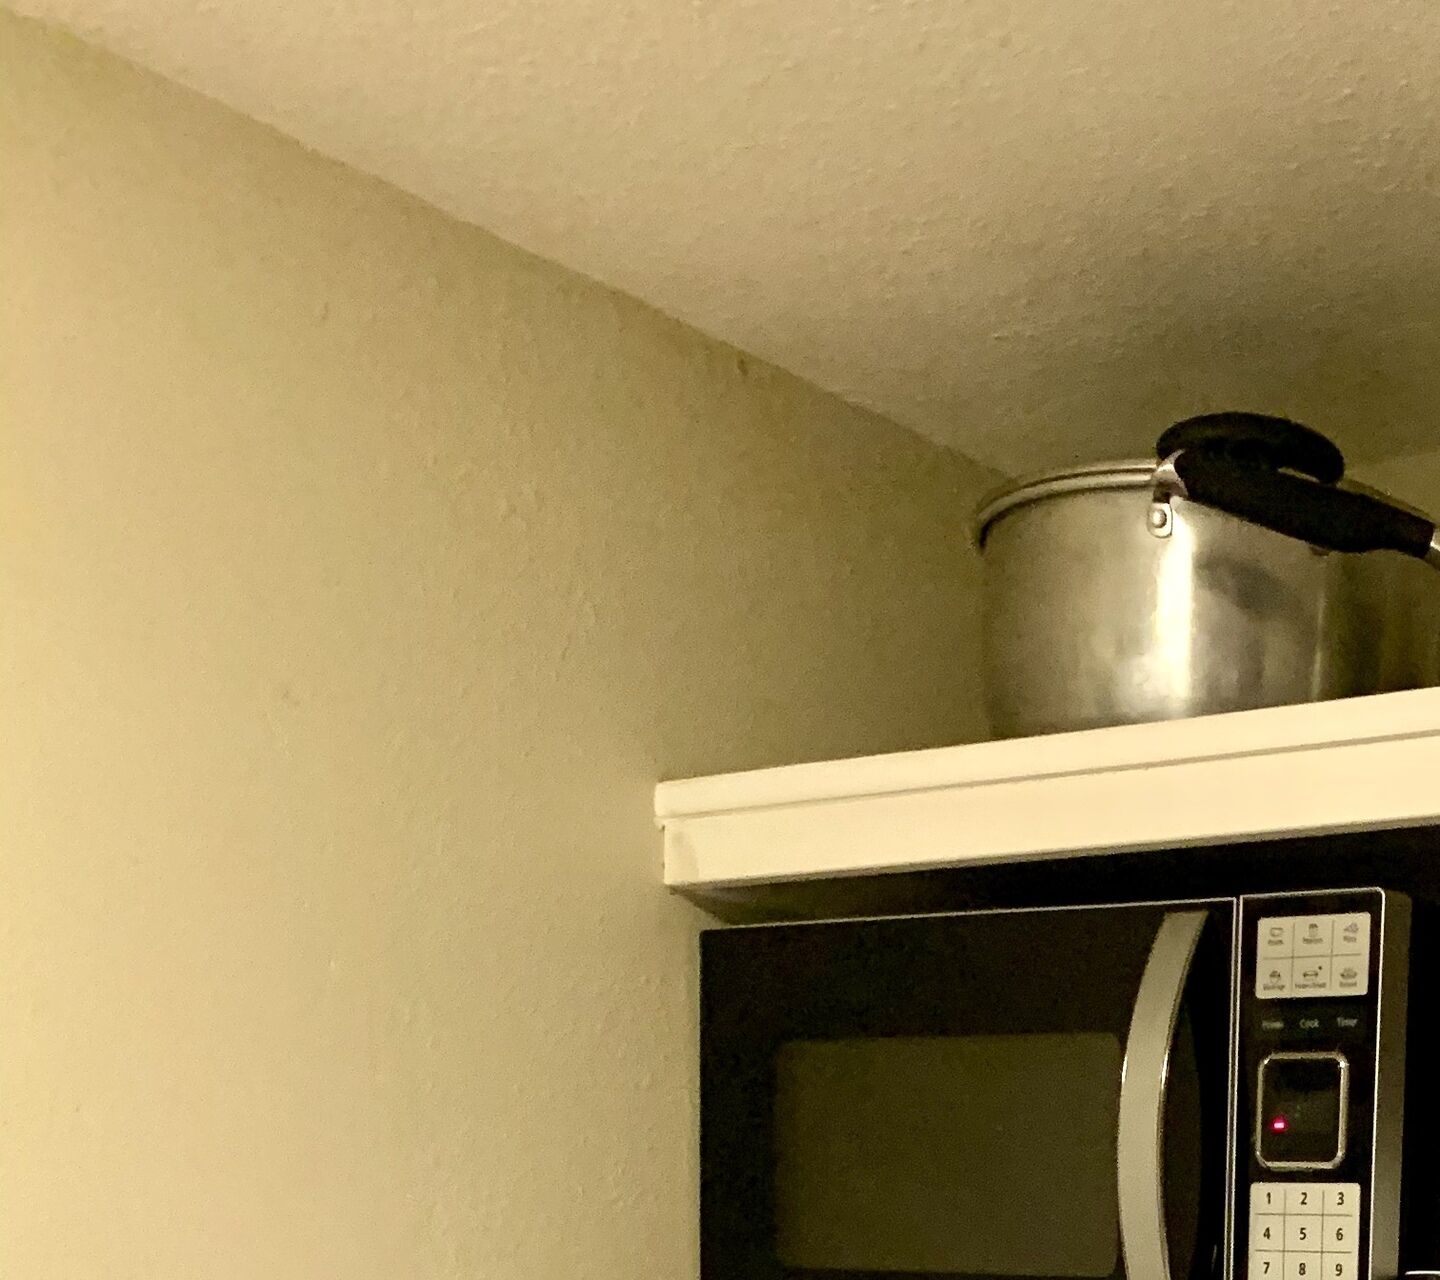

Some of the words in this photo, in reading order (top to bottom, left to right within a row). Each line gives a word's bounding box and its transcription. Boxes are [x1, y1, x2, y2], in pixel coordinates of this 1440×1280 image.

[1266, 1192, 1272, 1204] 1
[1300, 1192, 1308, 1205] 2
[1336, 1192, 1344, 1206] 3
[1263, 1227, 1271, 1240] 4
[1299, 1228, 1306, 1240] 5
[1336, 1228, 1344, 1241] 6
[1263, 1262, 1270, 1274] 7
[1298, 1262, 1306, 1276] 8
[1336, 1264, 1342, 1276] 9
